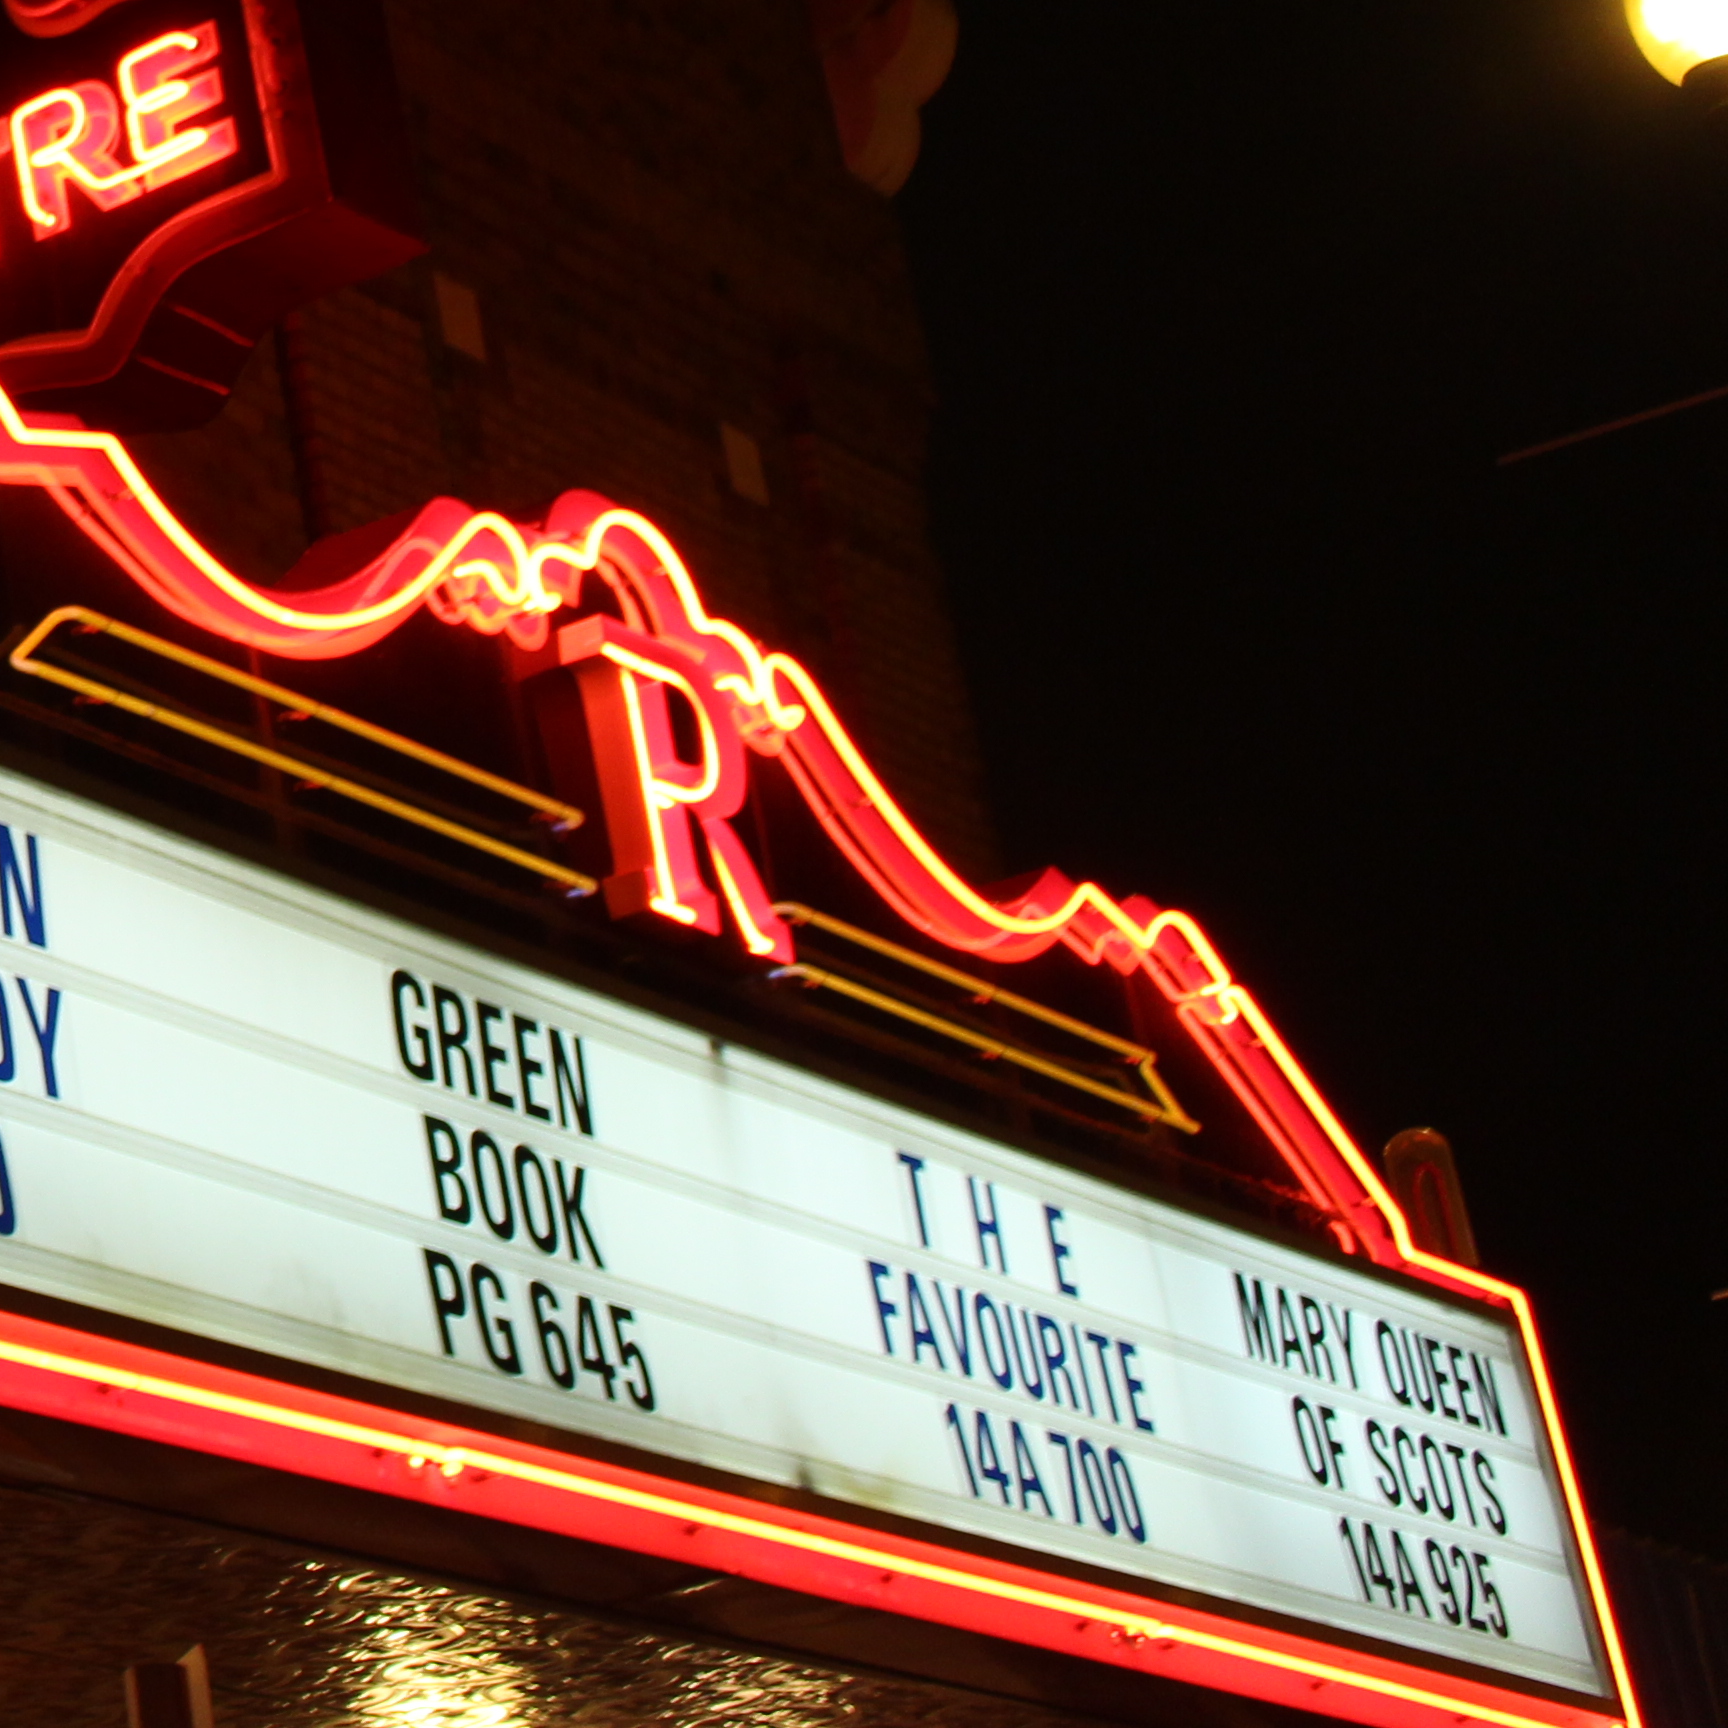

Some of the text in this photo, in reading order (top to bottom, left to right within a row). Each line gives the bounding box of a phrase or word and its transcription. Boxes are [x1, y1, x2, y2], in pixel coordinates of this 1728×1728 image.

[562, 614, 789, 966] R
[391, 970, 594, 1137] GREEN
[425, 1115, 605, 1269] BOOK
[425, 1249, 656, 1413] PG 645
[867, 1261, 1153, 1434] FAVOURITE
[1233, 1272, 1507, 1437] MARY QUEEN
[944, 1403, 1148, 1545] 14A 700
[1292, 1395, 1508, 1537] OF SCOTS
[1339, 1515, 1510, 1640] 14A 925
